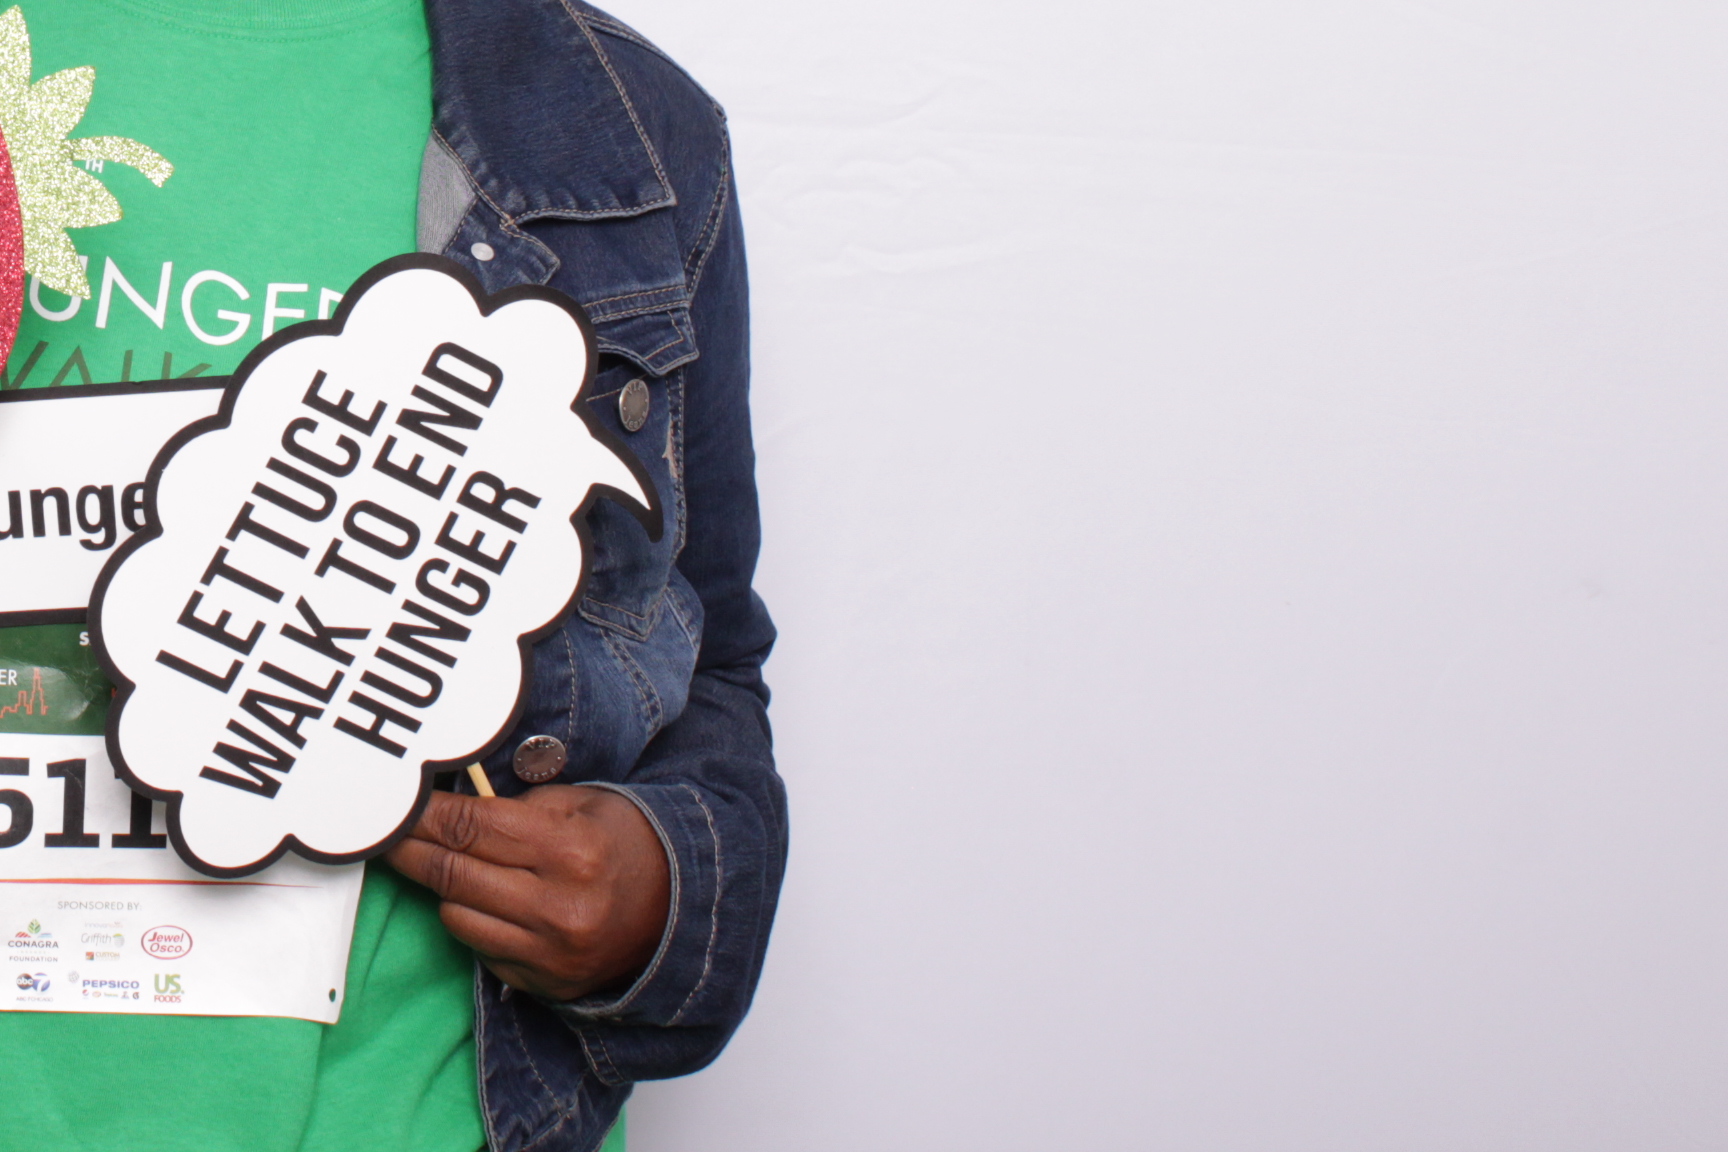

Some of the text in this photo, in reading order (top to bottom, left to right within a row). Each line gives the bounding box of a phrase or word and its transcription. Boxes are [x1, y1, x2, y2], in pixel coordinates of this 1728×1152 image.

[155, 369, 388, 694] LETTUCE
[198, 341, 504, 800] WALK TO END
[333, 470, 542, 759] HUNGER
[57, 900, 143, 912] SPONSORED BY:
[148, 931, 185, 944] Jewel
[8, 940, 59, 949] CONAGRA
[9, 955, 59, 963] FOUNDATION
[16, 976, 33, 985] abc
[82, 979, 140, 990] PEPSICO
[154, 995, 182, 1003] FOODS
